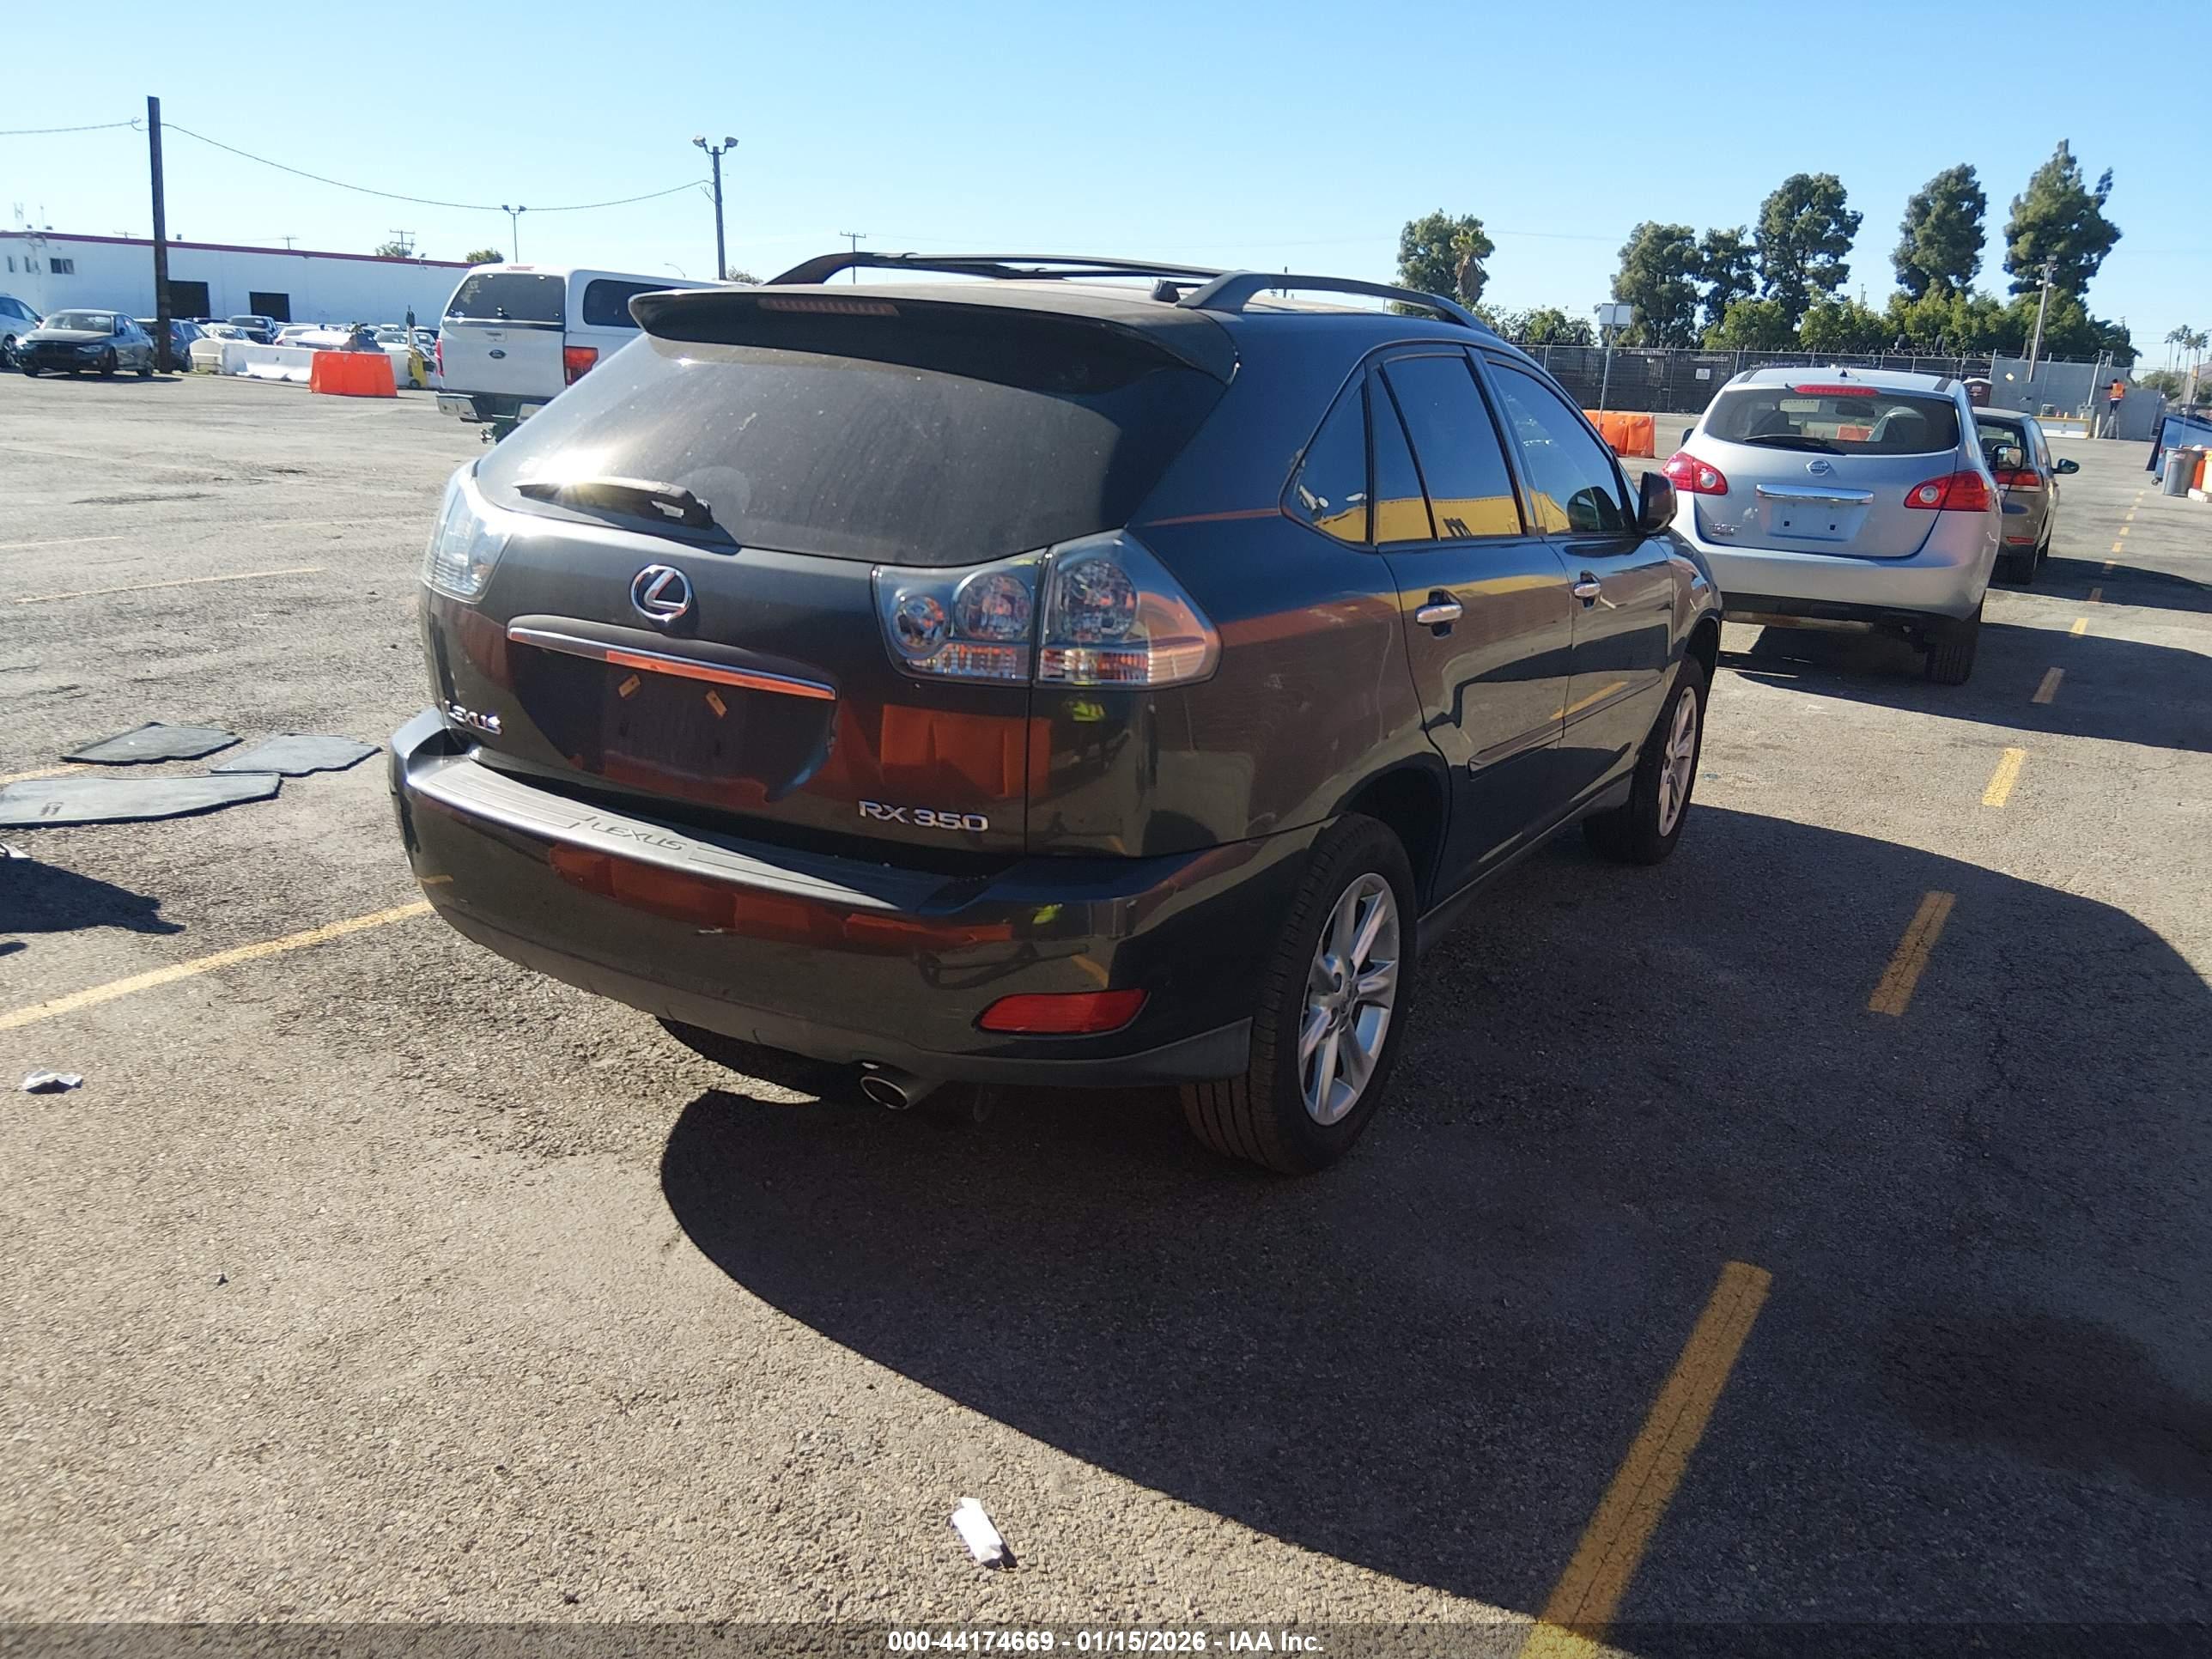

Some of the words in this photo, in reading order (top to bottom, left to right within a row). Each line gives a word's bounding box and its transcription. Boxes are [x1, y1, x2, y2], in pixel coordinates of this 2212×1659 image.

[858, 799, 910, 824] RX
[913, 808, 989, 832] 350
[591, 822, 687, 851] LEXUS
